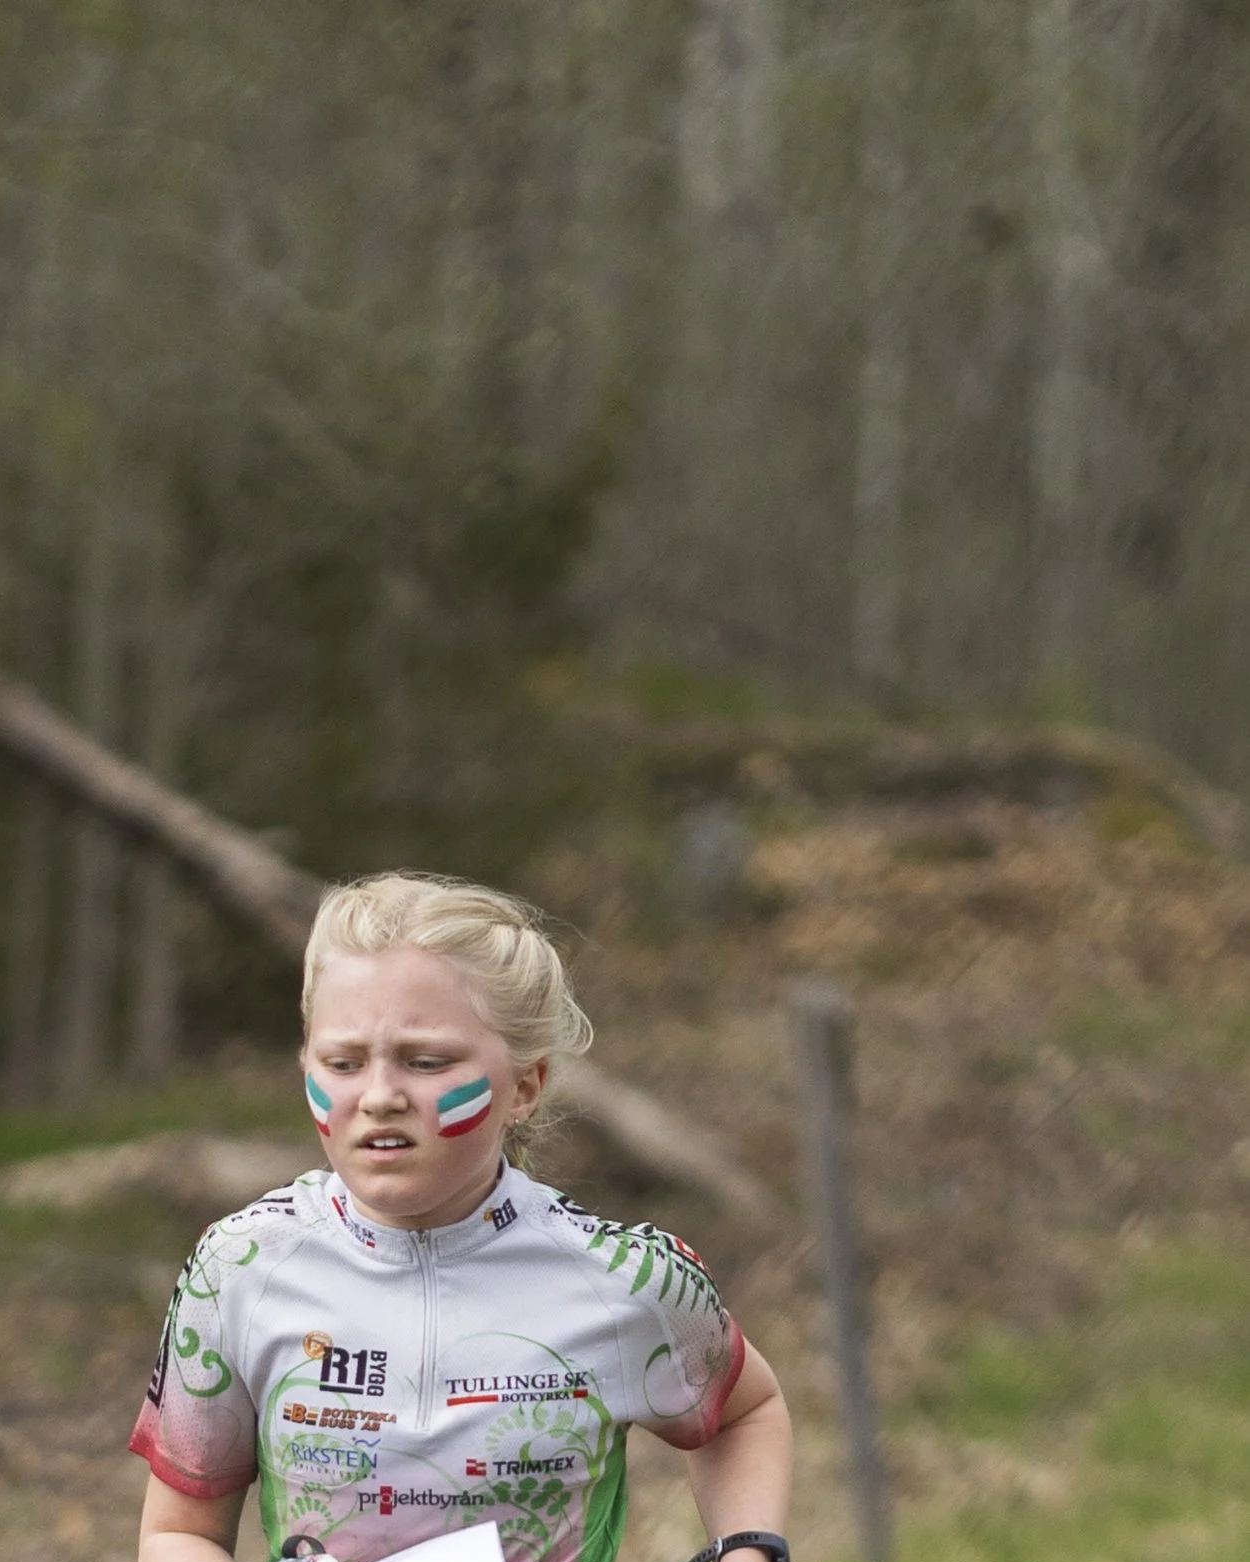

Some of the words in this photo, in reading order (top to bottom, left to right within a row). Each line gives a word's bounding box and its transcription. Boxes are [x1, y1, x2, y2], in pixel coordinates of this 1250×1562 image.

[319, 1346, 368, 1386] R1
[367, 1350, 387, 1397] BYGG
[446, 1373, 559, 1394] TULLINGE
[563, 1371, 588, 1387] SK
[501, 1391, 570, 1403] BOTKYRKA
[493, 1456, 575, 1476] TRIMTEX
[358, 1488, 484, 1511] projektbyrån
